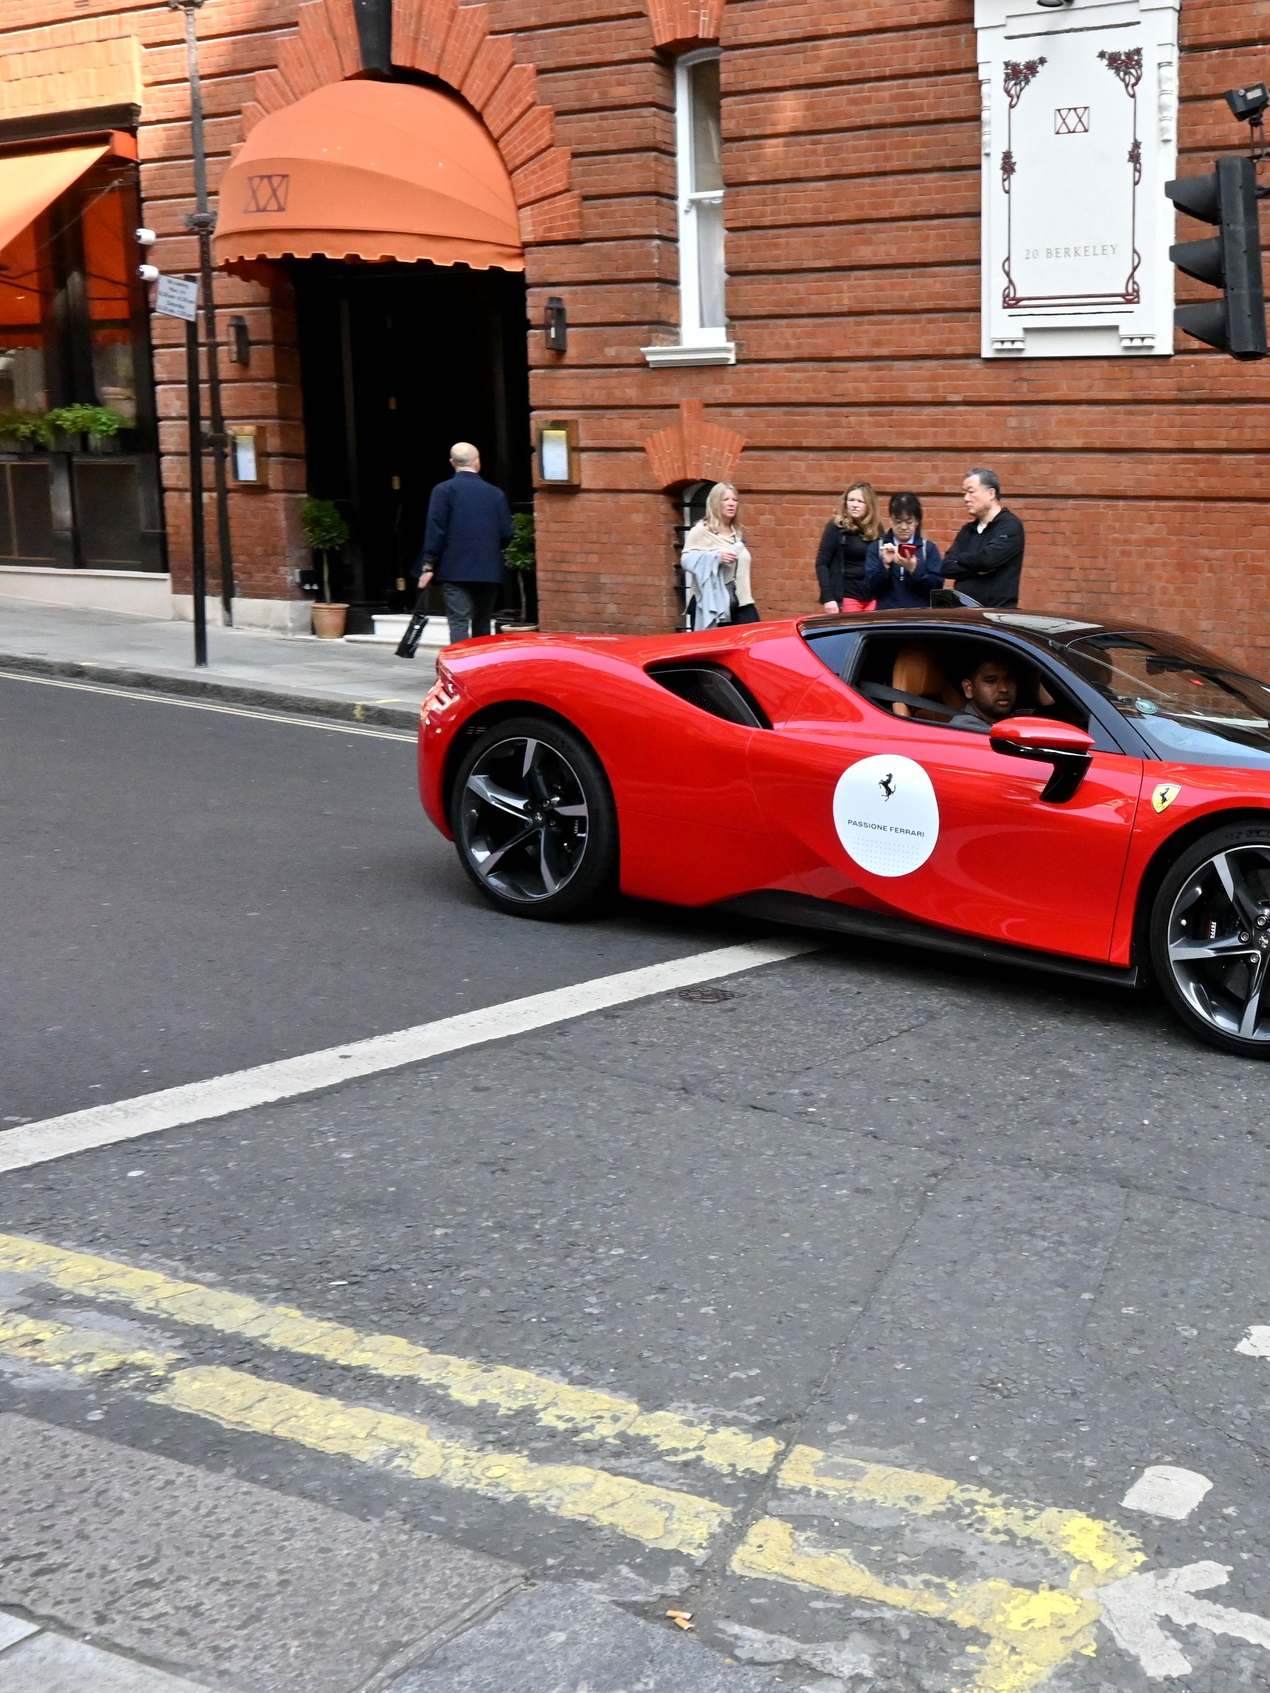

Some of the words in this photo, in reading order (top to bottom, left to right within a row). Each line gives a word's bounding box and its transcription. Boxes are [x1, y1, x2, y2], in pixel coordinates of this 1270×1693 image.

[1025, 249, 1039, 260] 20
[1046, 244, 1119, 259] BERKELEY
[847, 819, 888, 832] PASSIONE
[889, 826, 925, 838] FERRARI
